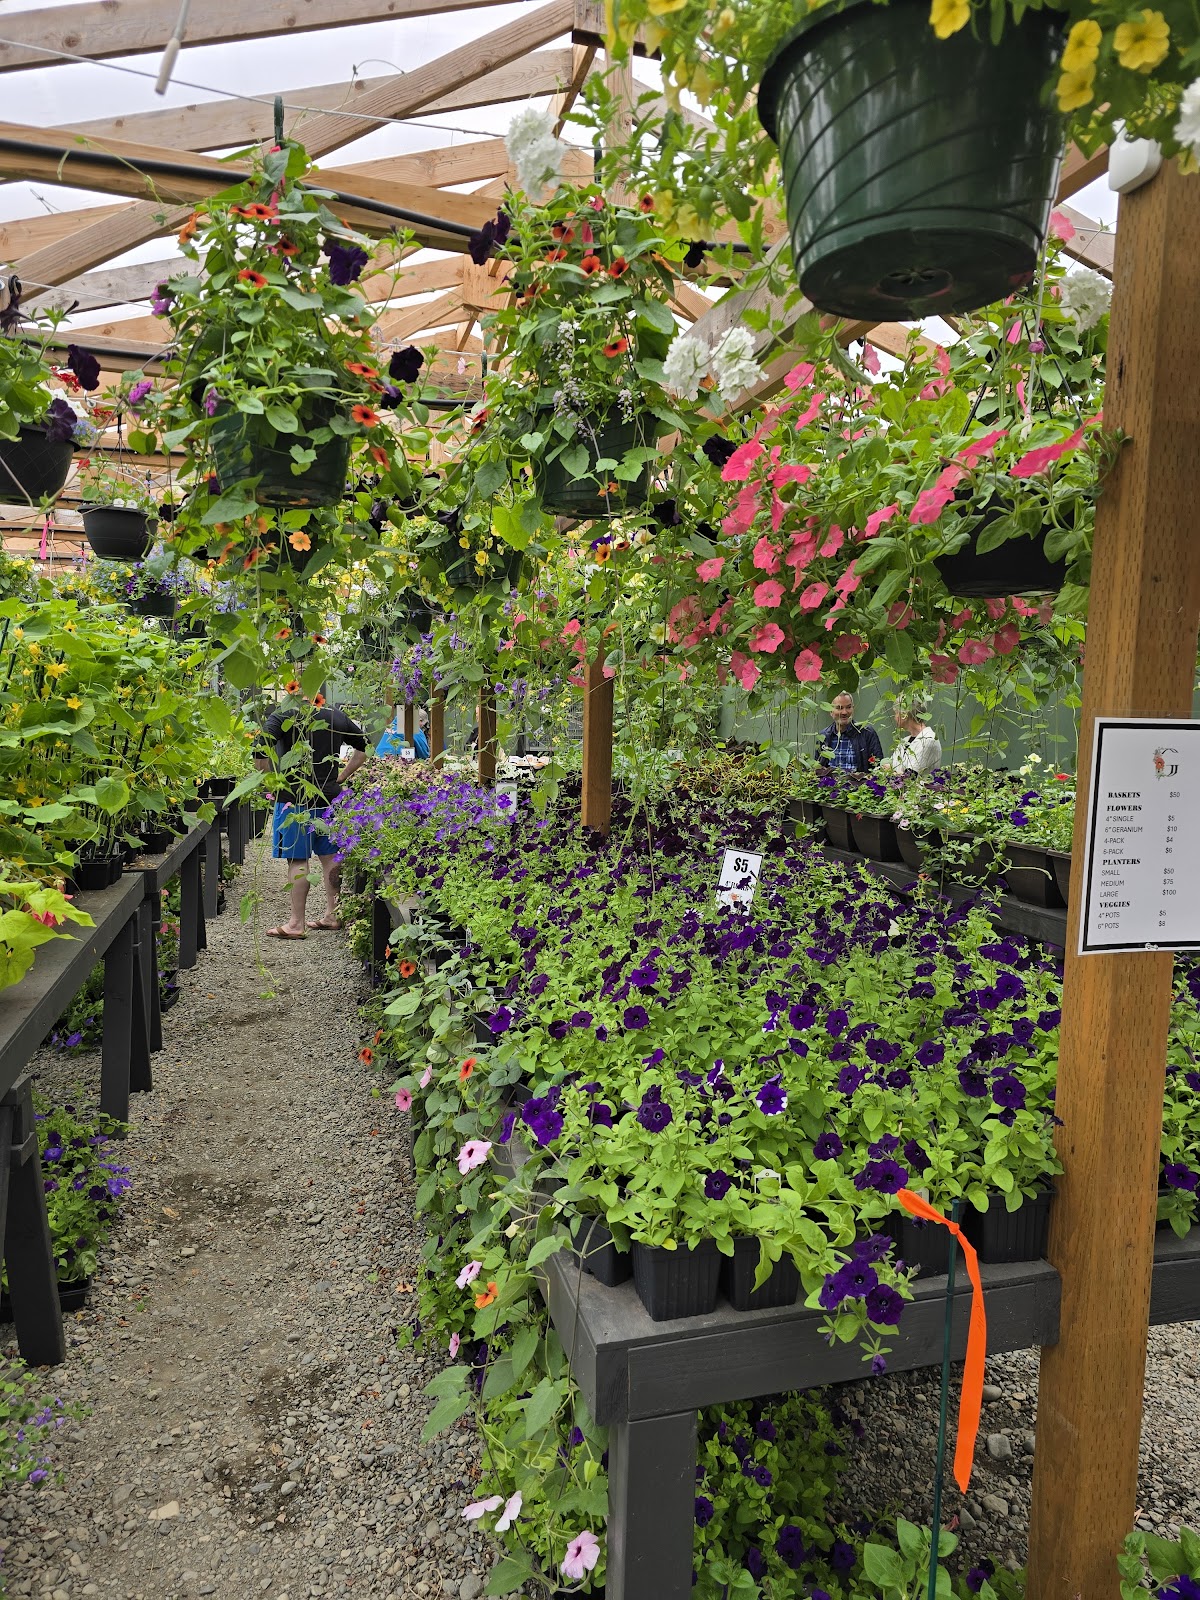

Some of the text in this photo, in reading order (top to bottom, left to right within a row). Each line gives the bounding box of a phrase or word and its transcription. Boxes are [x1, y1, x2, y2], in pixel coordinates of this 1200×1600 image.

[733, 857, 748, 872] $5
[1102, 858, 1141, 866] PLANTERS
[1105, 911, 1120, 919] POTS
